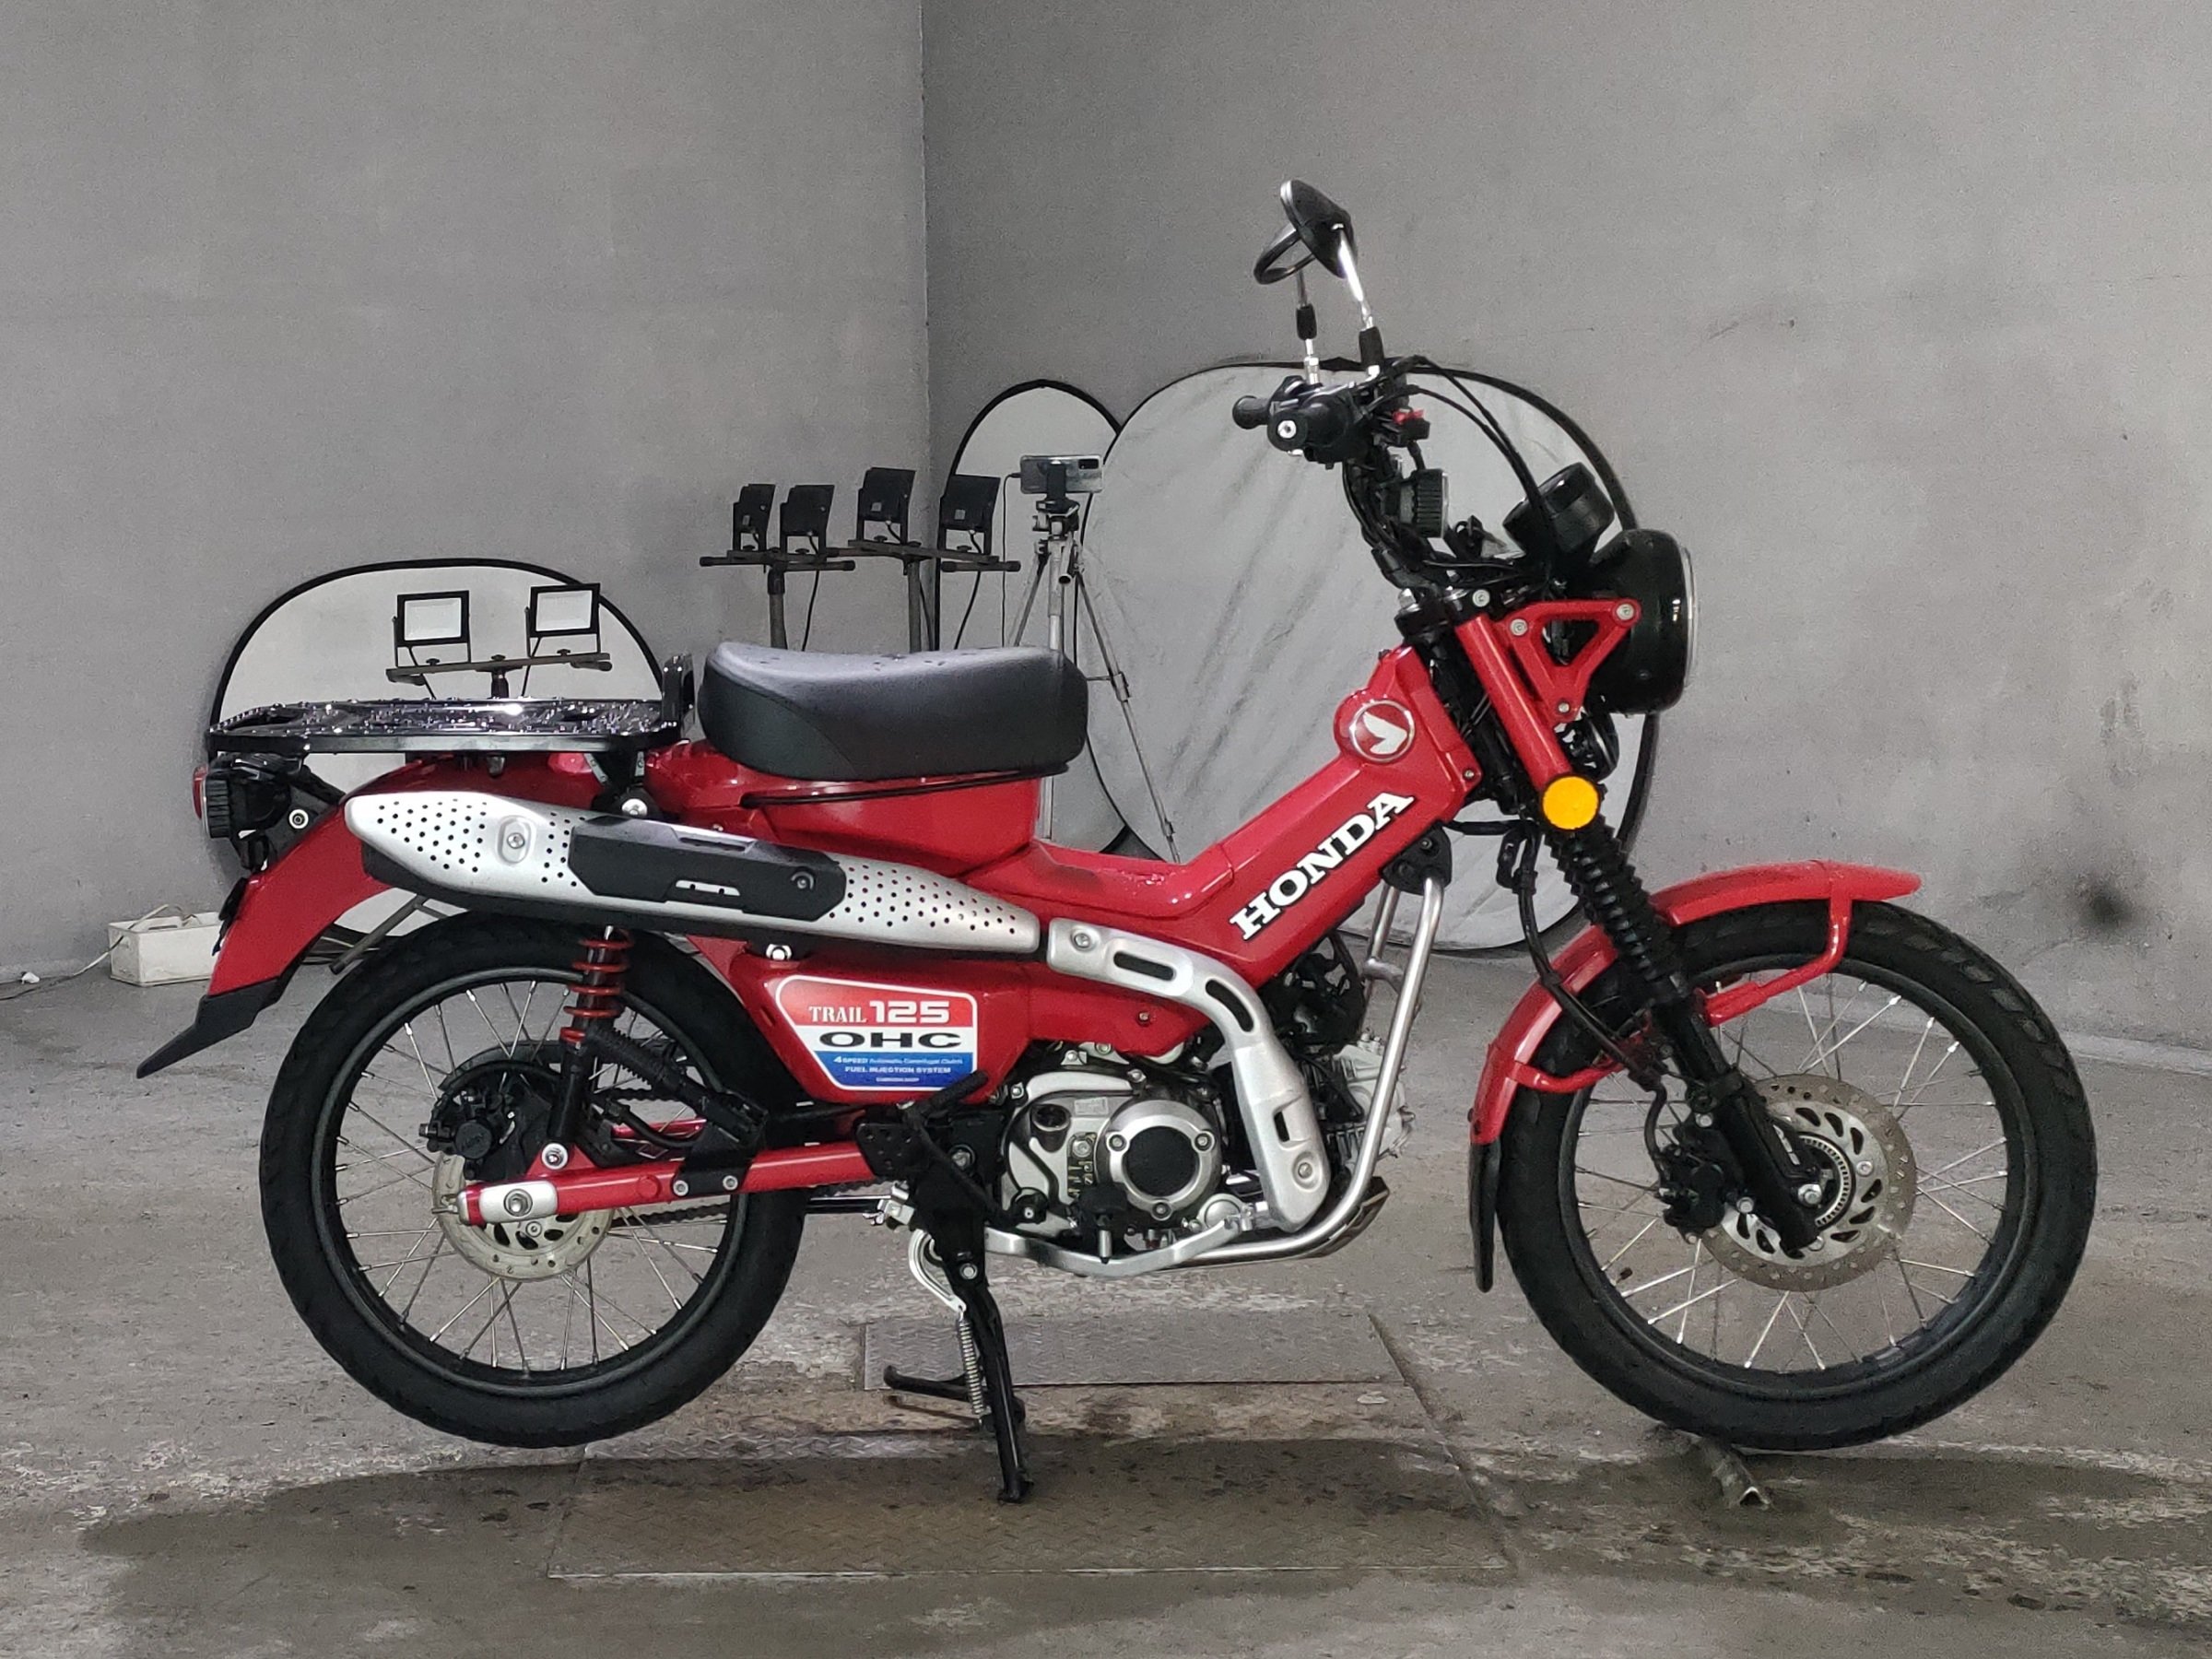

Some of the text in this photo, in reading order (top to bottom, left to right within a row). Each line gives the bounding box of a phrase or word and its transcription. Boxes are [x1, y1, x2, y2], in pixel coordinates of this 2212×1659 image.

[1229, 792, 1414, 940] HONDA
[808, 1000, 949, 1023] TRAIL 125
[819, 1031, 961, 1048] OHC
